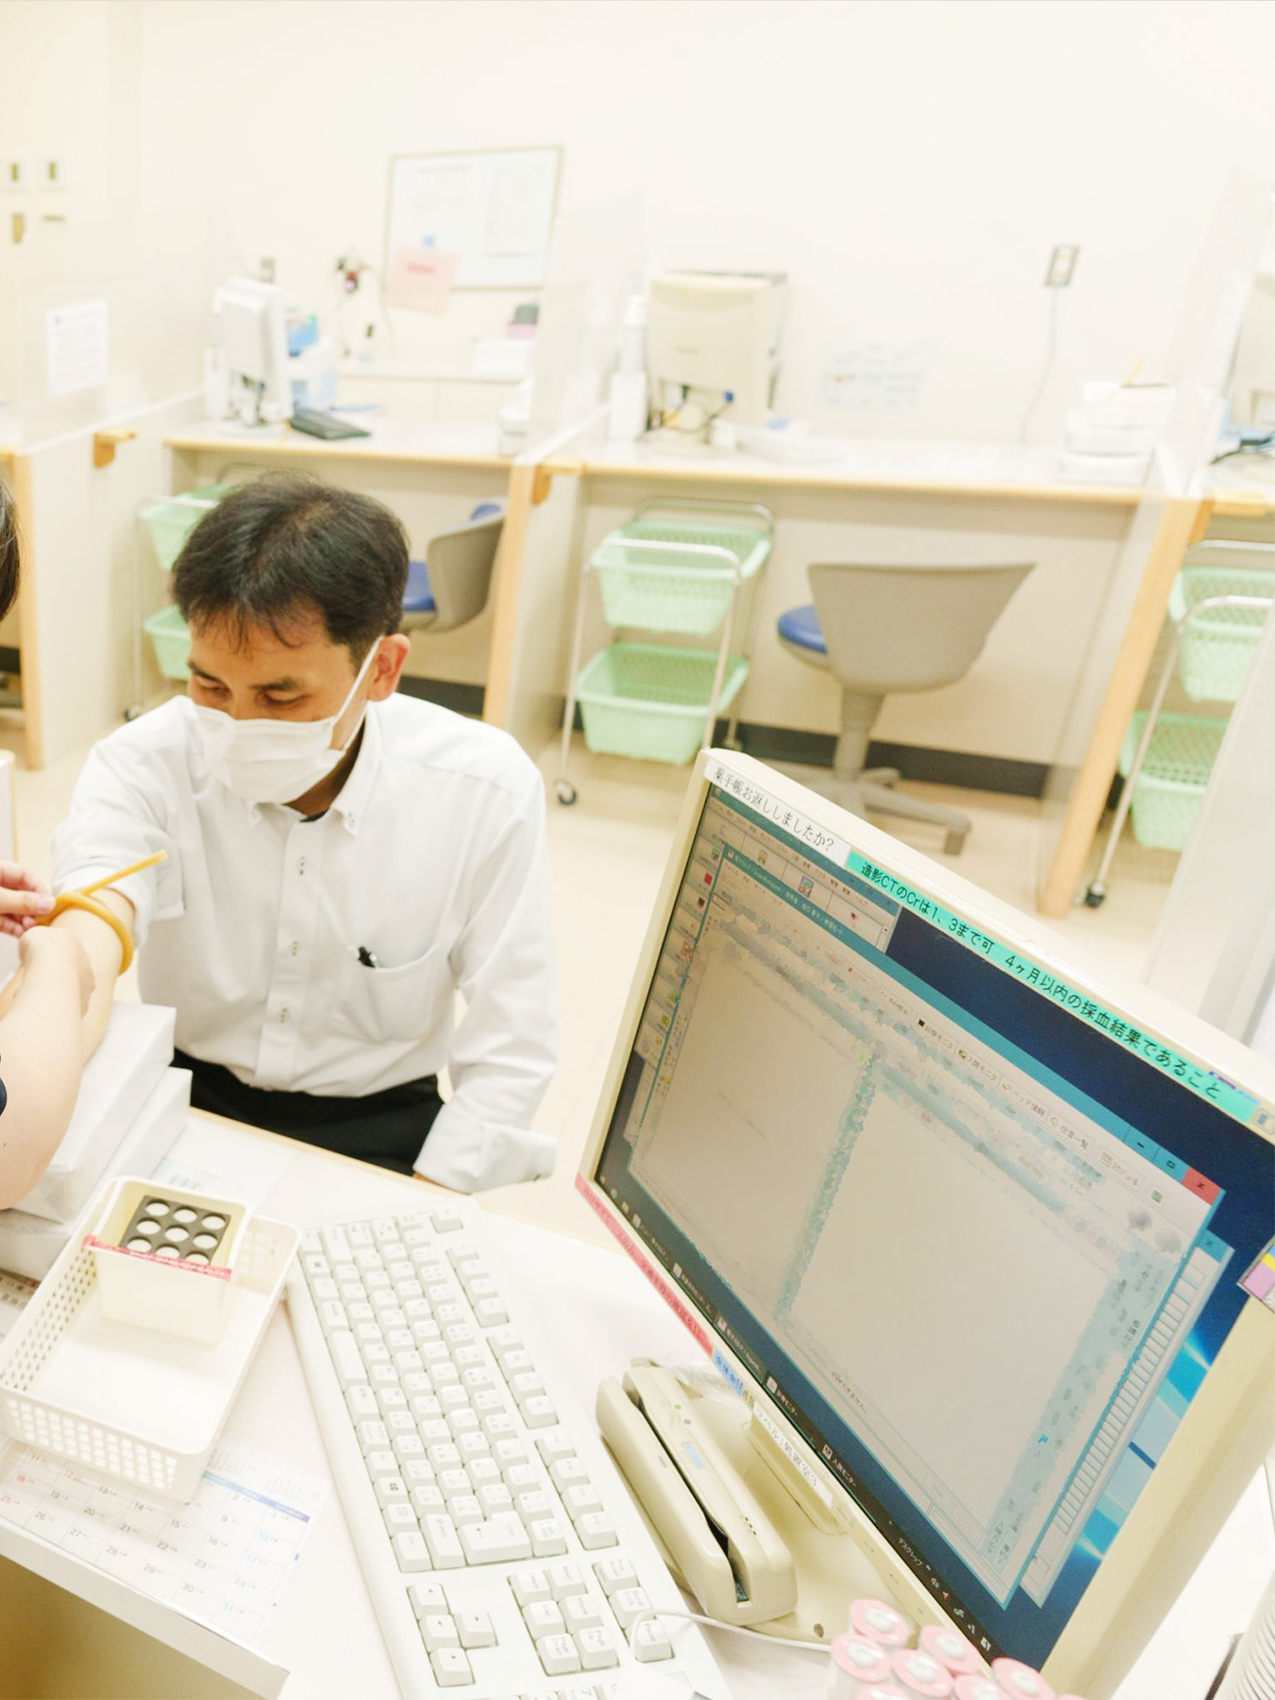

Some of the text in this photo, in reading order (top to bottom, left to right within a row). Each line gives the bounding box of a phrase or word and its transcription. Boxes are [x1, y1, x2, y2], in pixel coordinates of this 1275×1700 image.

[859, 861, 993, 954] 造影CTのCrは1、3まで可
[1004, 955, 1221, 1100] 4ヶ月以内の採血結果であること
[644, 1623, 657, 1643] Pause
